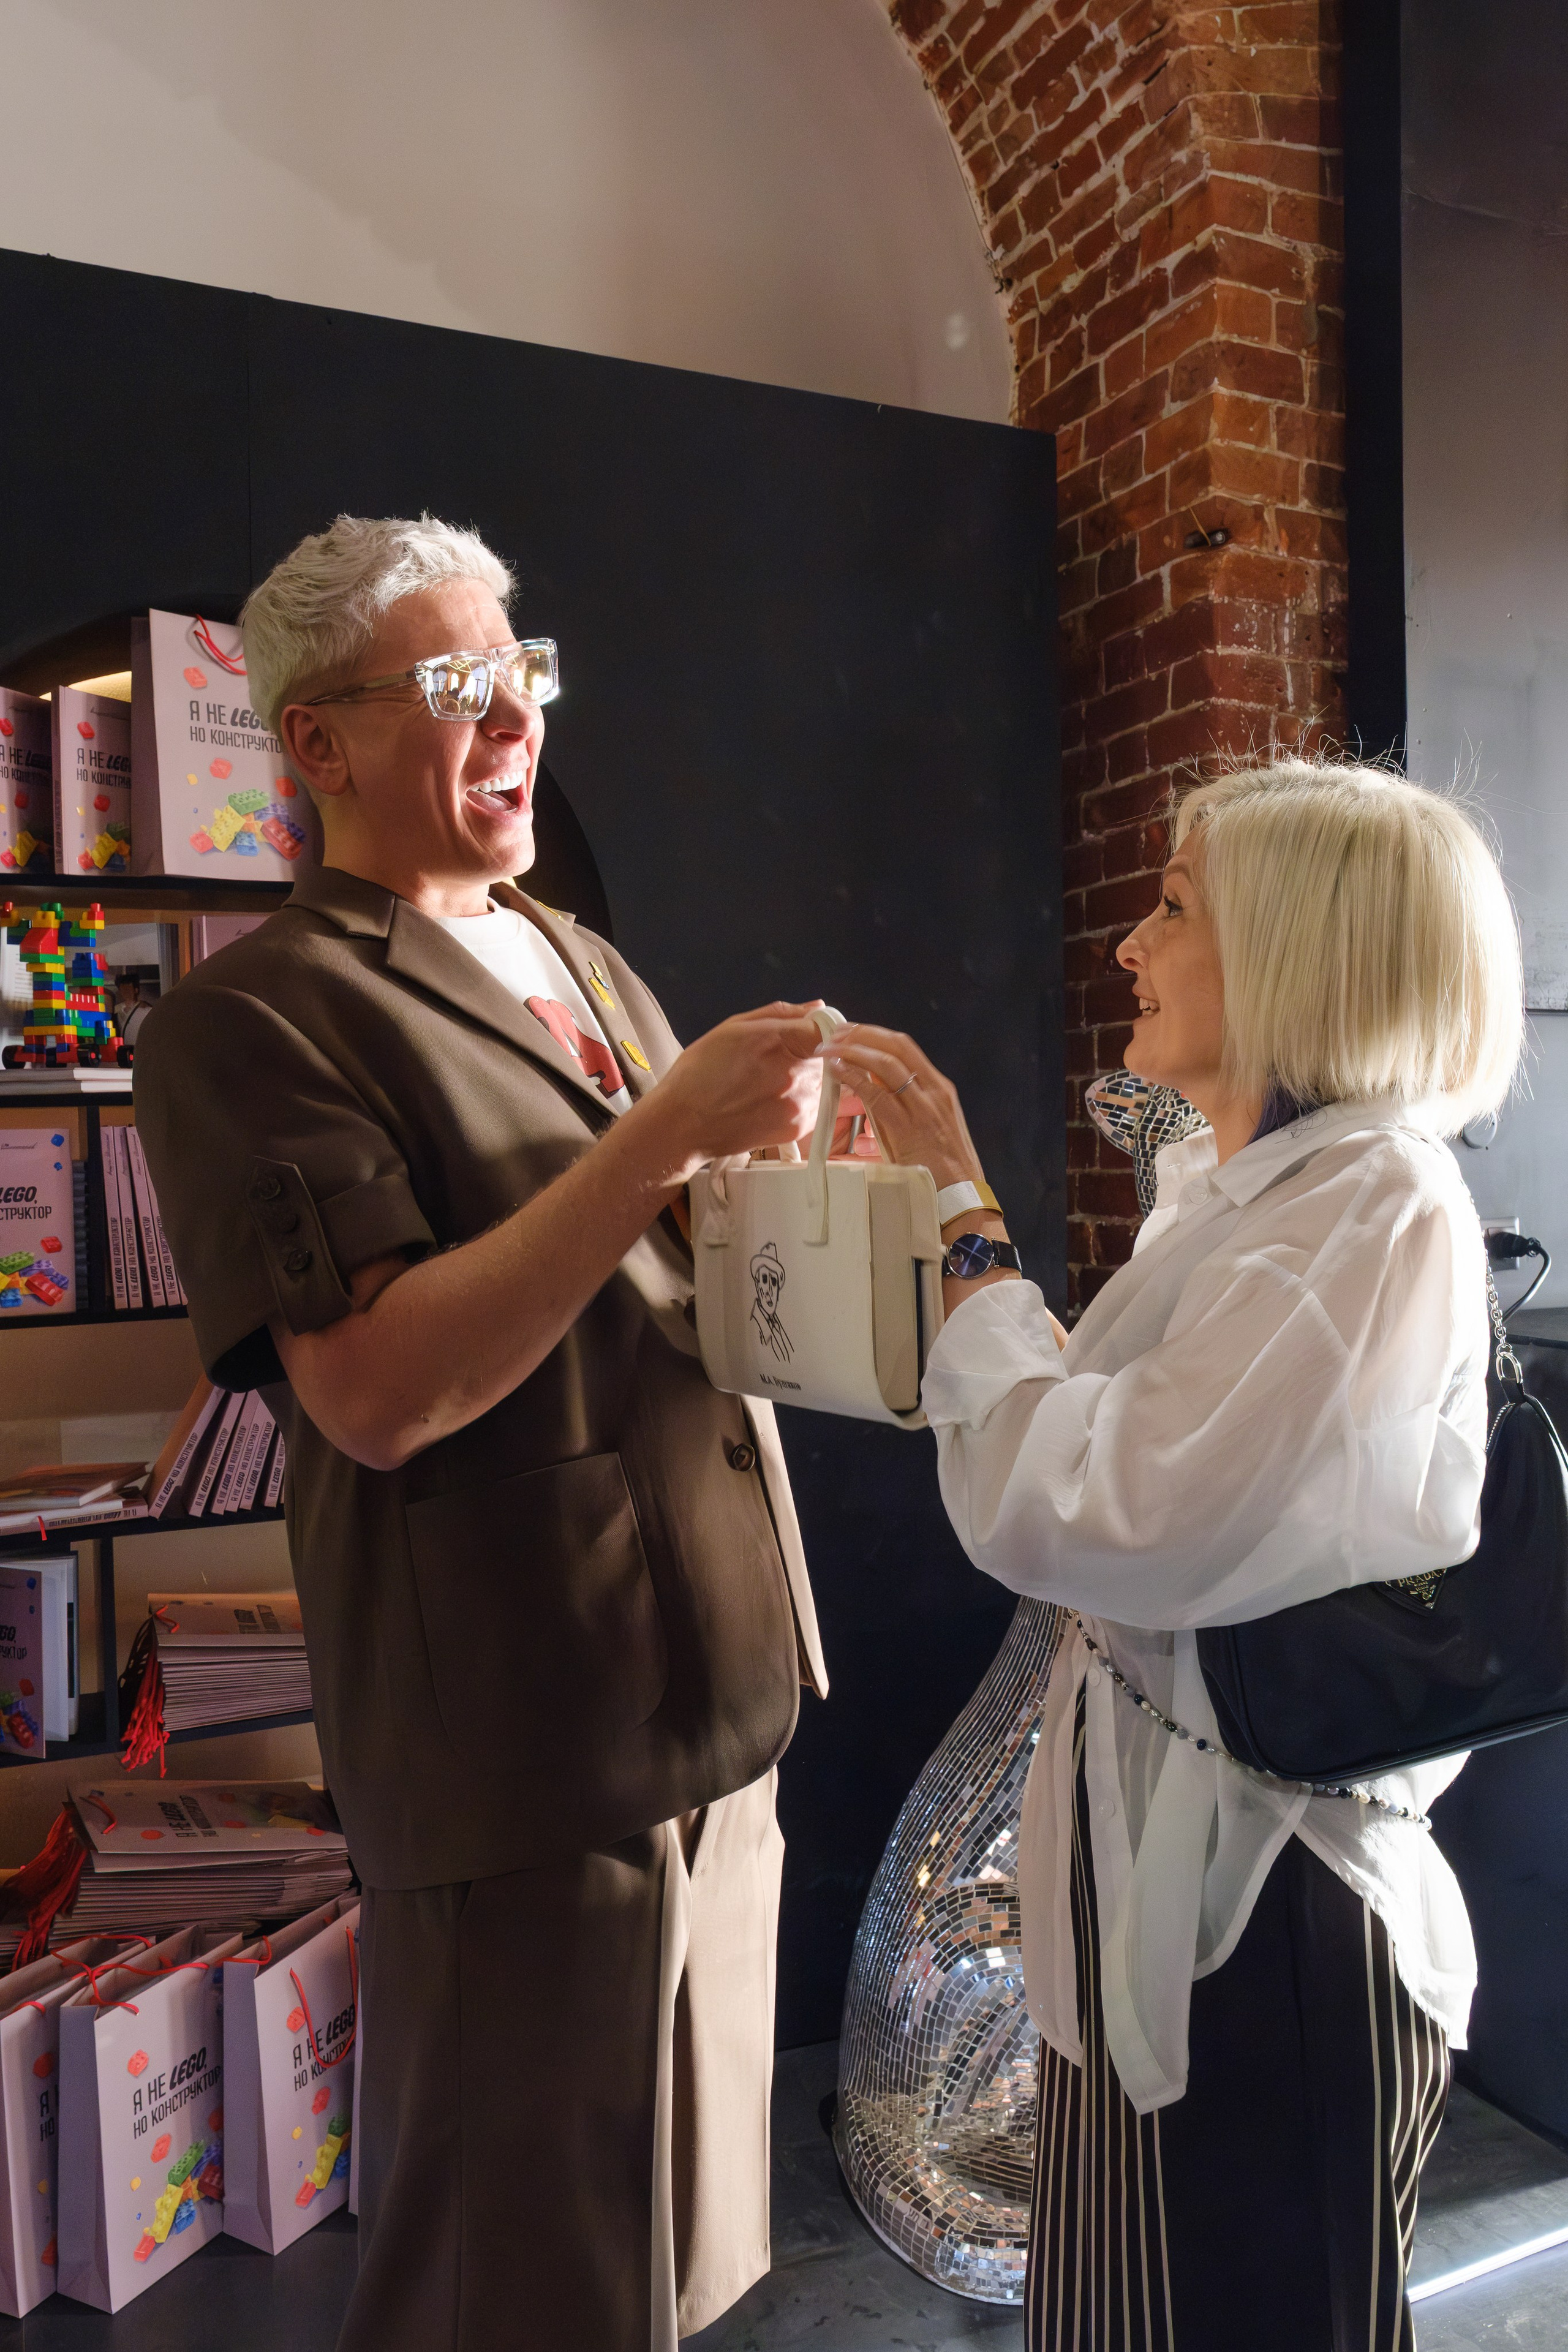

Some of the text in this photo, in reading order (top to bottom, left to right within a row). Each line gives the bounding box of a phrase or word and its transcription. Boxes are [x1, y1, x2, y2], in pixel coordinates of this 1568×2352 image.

[190, 700, 269, 731] Я НЕ LEG
[190, 726, 206, 742] НО
[9, 747, 23, 765] НЕ
[77, 748, 85, 764] Я
[89, 750, 104, 768] НЕ
[77, 768, 88, 782] НО
[1397, 1571, 1440, 1587] PRADA
[293, 2043, 302, 2069] Я
[134, 2046, 207, 2115] Я НЕ LEGO,
[294, 2069, 307, 2092] НО
[40, 2090, 49, 2117] Я
[134, 2065, 221, 2139] НО КОНСТРУКТОР
[40, 2117, 55, 2141] НО
